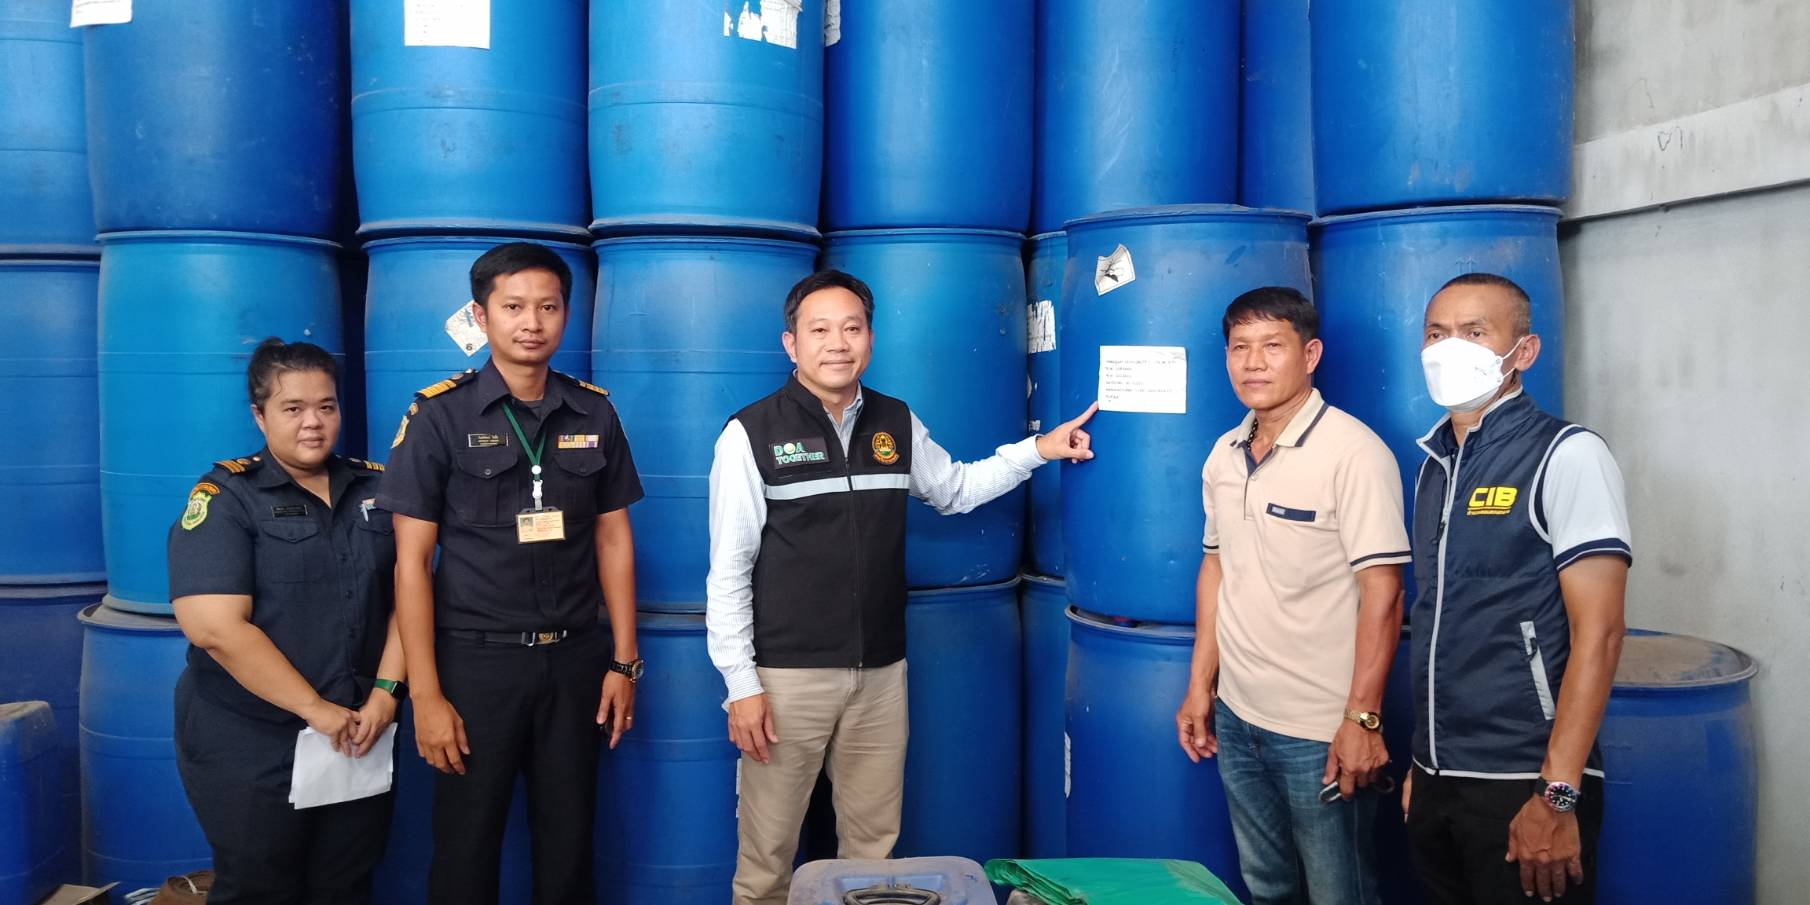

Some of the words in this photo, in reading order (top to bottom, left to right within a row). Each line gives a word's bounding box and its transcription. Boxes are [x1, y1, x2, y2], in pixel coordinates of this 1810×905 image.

[465, 343, 473, 351] 6
[773, 442, 805, 457] DOA
[775, 451, 825, 465] TOGETHER
[1469, 486, 1518, 507] CIB
